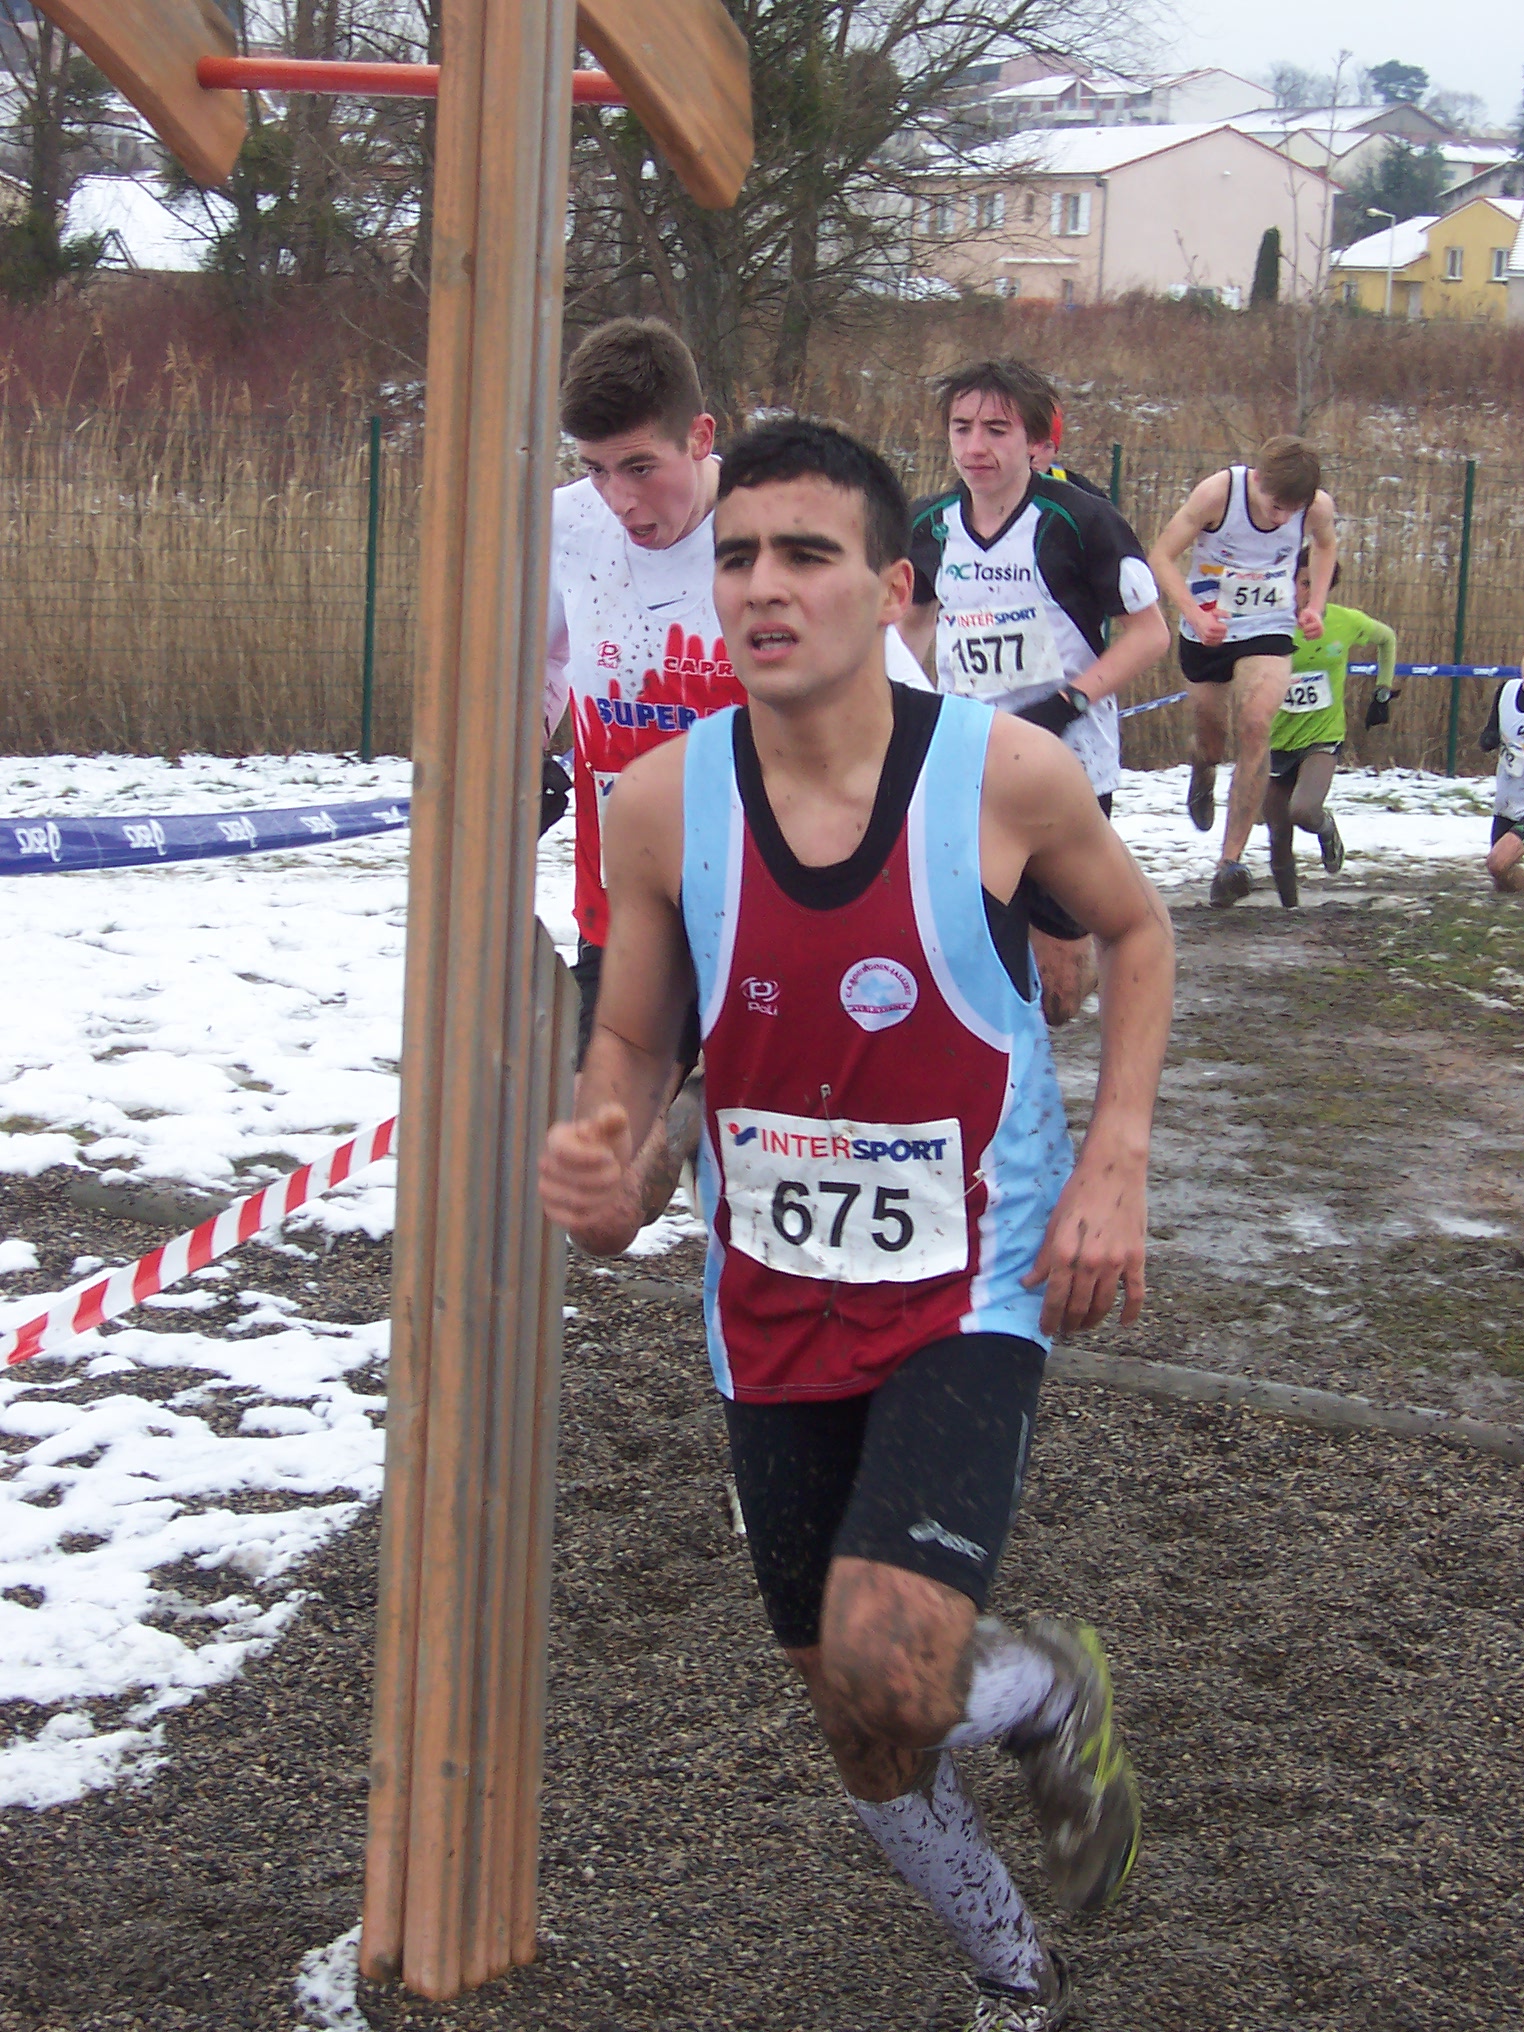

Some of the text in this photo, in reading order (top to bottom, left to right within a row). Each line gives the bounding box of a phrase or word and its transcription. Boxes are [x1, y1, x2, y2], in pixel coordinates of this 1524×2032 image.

[1234, 586, 1278, 608] 514
[957, 607, 1037, 627] INTERSPORT
[952, 632, 1025, 675] 1577
[596, 698, 697, 731] SUPER
[761, 1128, 947, 1163] INTERSPORT
[771, 1179, 915, 1253] 675
